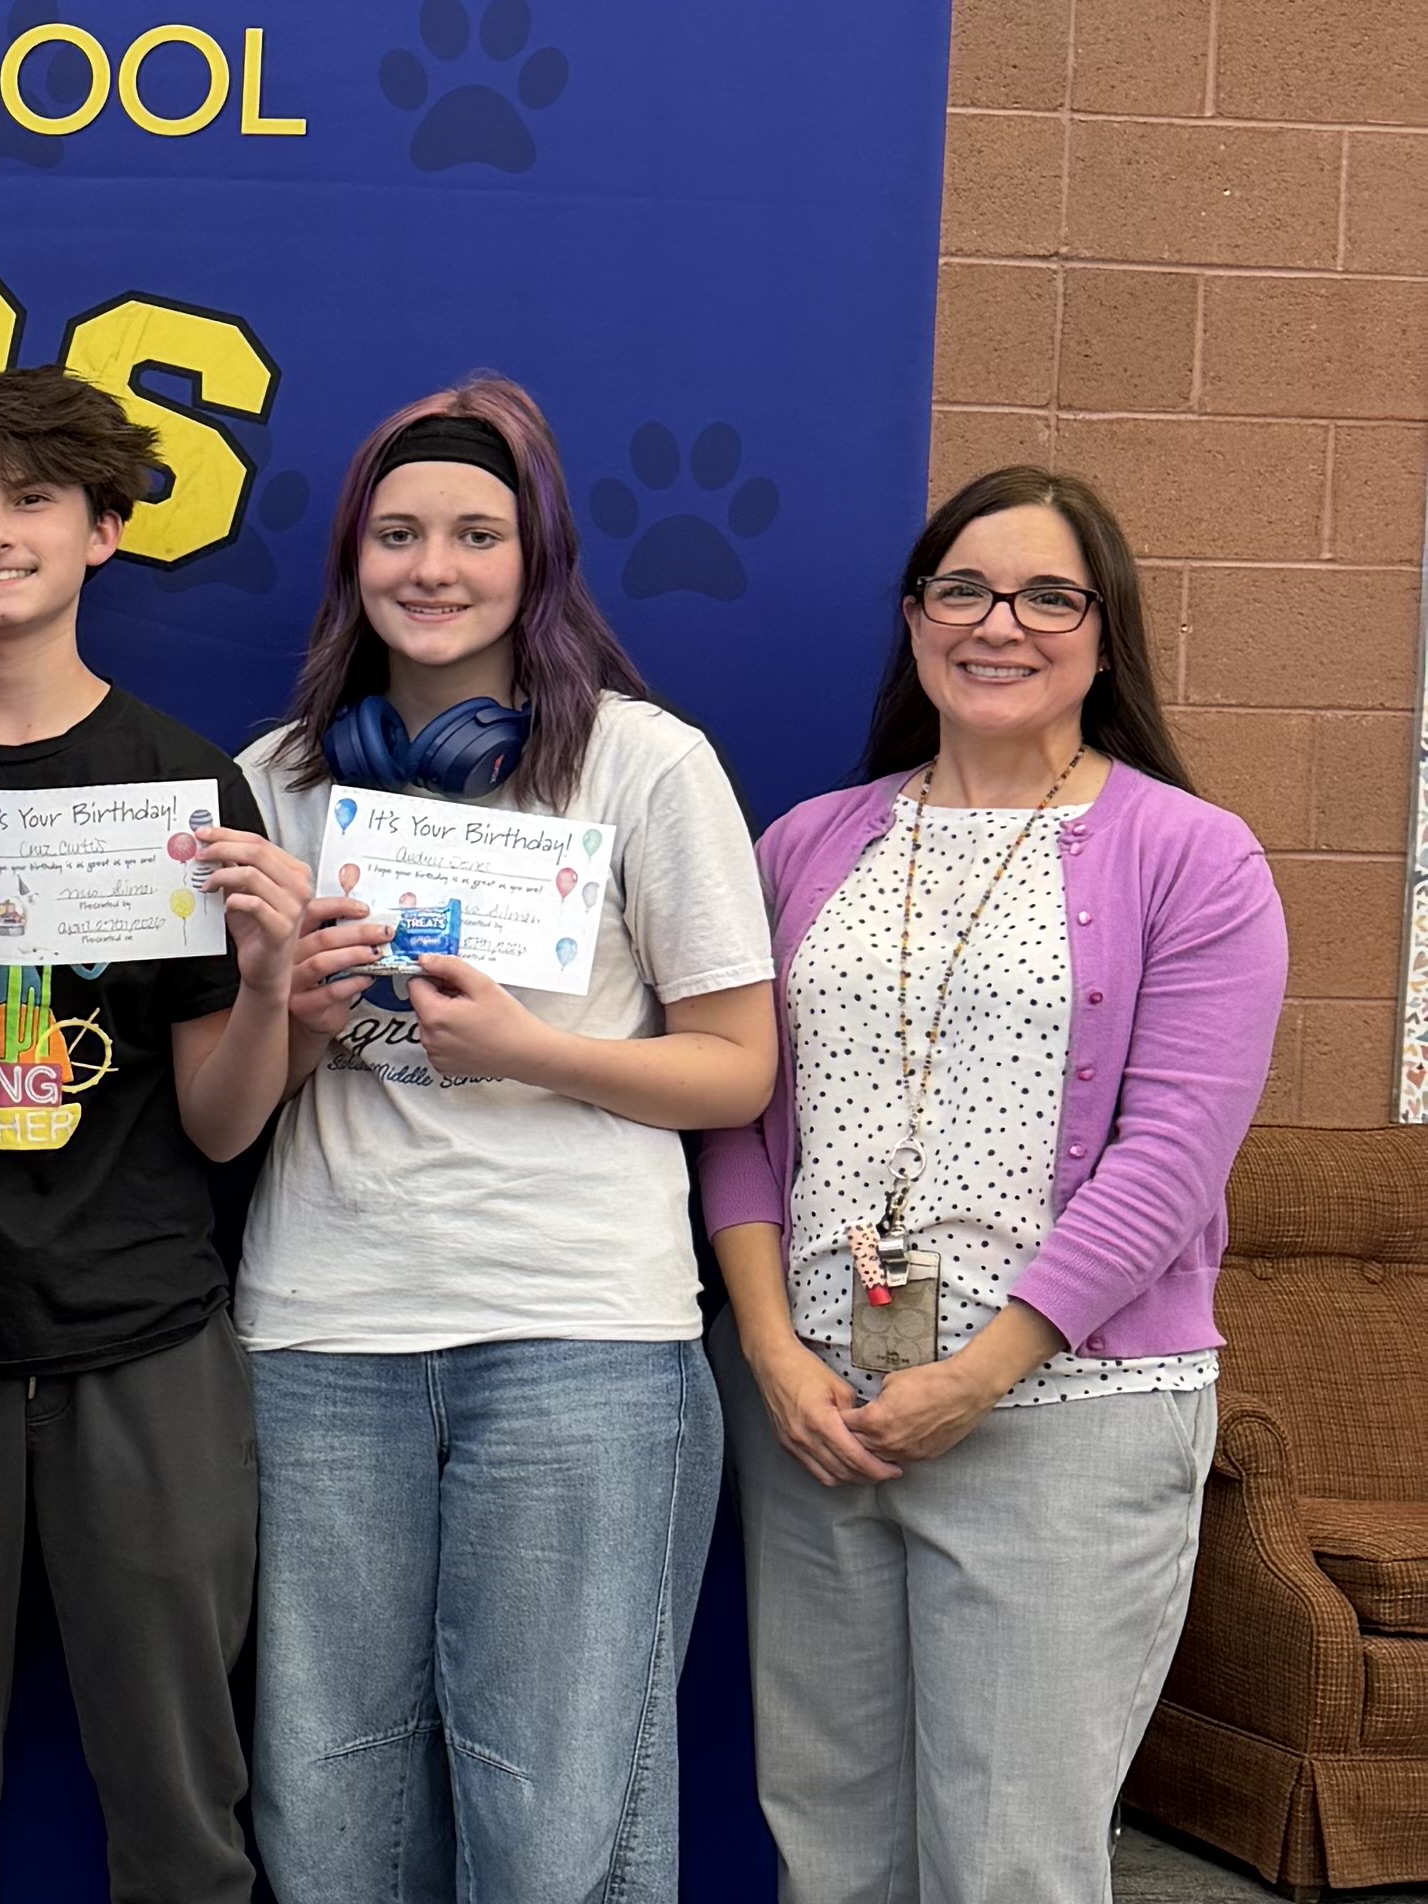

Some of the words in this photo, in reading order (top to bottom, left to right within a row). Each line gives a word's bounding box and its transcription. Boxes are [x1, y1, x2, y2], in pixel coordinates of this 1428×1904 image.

[19, 807, 62, 829] Your
[72, 795, 177, 831] Birthday!
[368, 809, 400, 833] It's
[412, 815, 456, 839] Your
[465, 823, 573, 865] Birthday!
[30, 862, 63, 873] birthday
[86, 859, 110, 873] great
